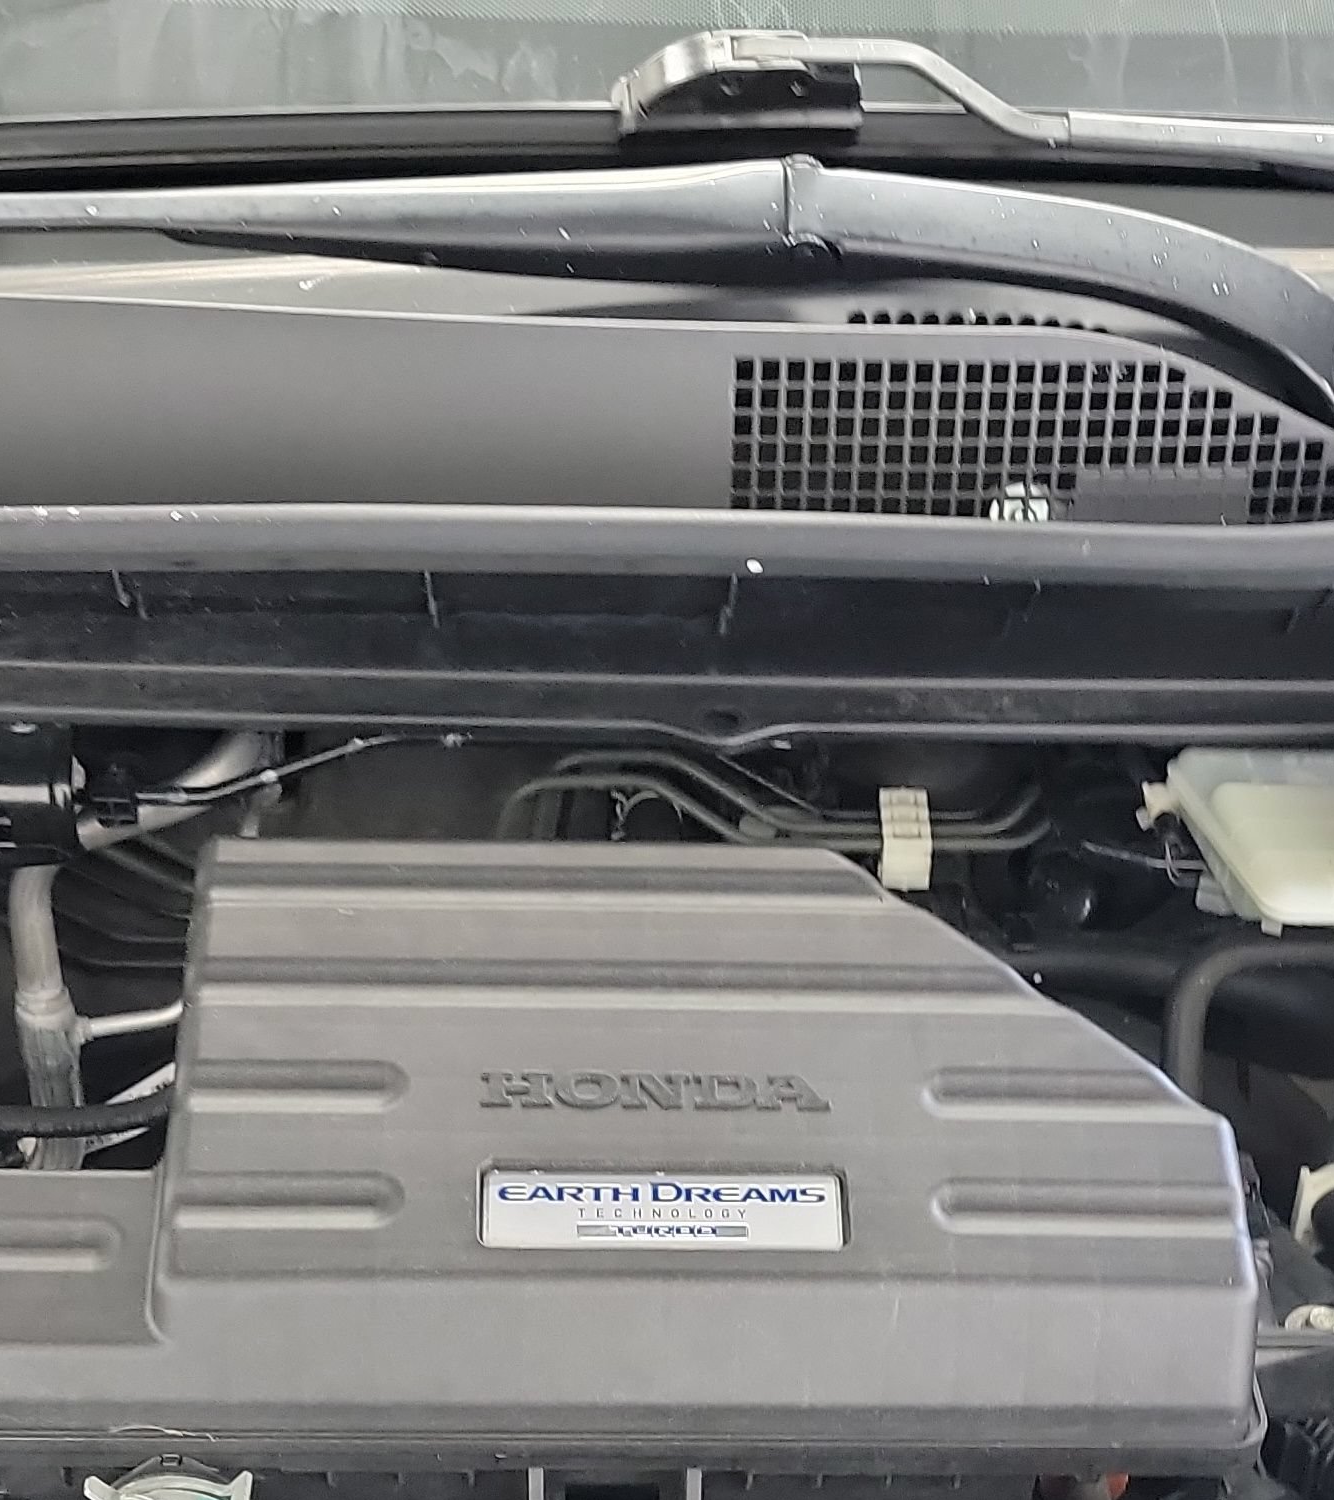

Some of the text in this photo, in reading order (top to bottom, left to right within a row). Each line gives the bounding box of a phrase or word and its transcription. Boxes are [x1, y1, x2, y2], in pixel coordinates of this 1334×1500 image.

[480, 1071, 832, 1112] HONDA
[497, 1181, 827, 1203] EARTH DREAMS
[578, 1208, 747, 1219] TECHNOLOGY
